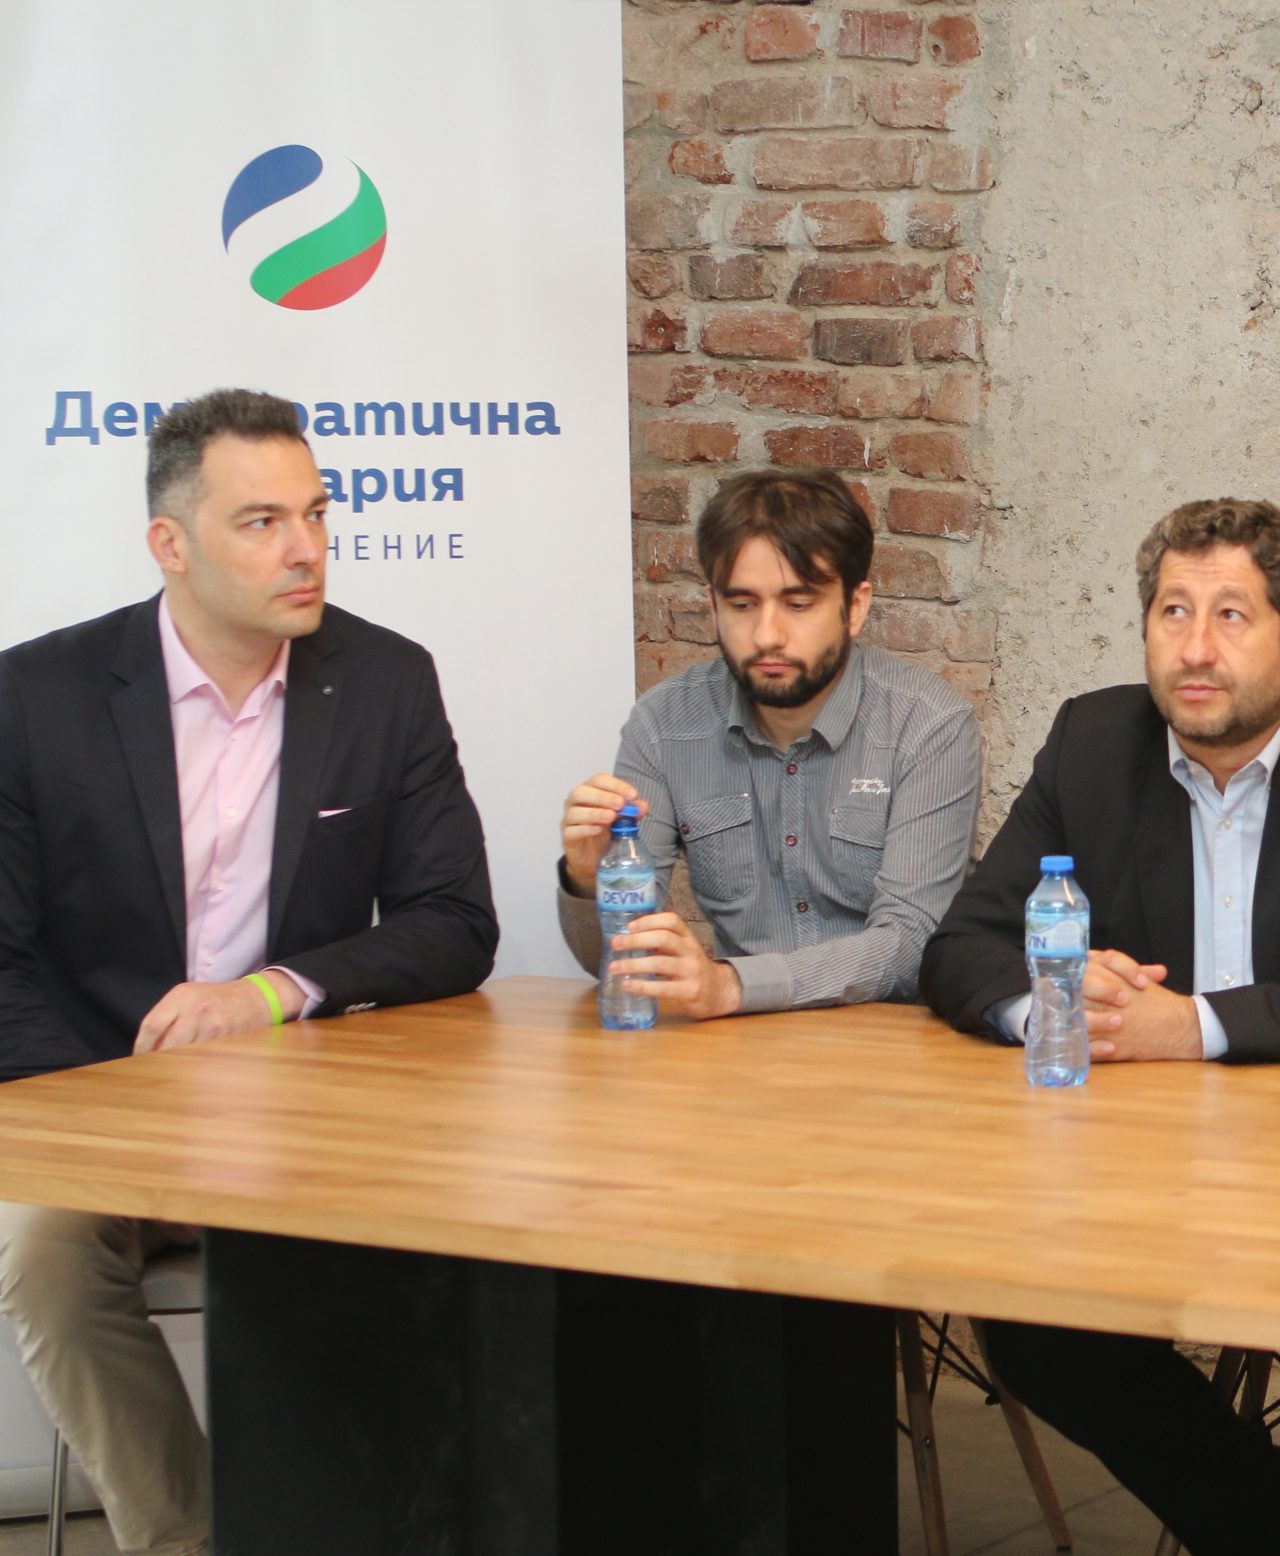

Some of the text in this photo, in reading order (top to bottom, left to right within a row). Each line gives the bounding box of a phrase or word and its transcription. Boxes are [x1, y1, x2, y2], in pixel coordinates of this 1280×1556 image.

[45, 390, 561, 446] Дематична
[317, 467, 464, 513] ария
[327, 533, 464, 560] НЕНИЕ
[603, 890, 645, 905] DEVIN
